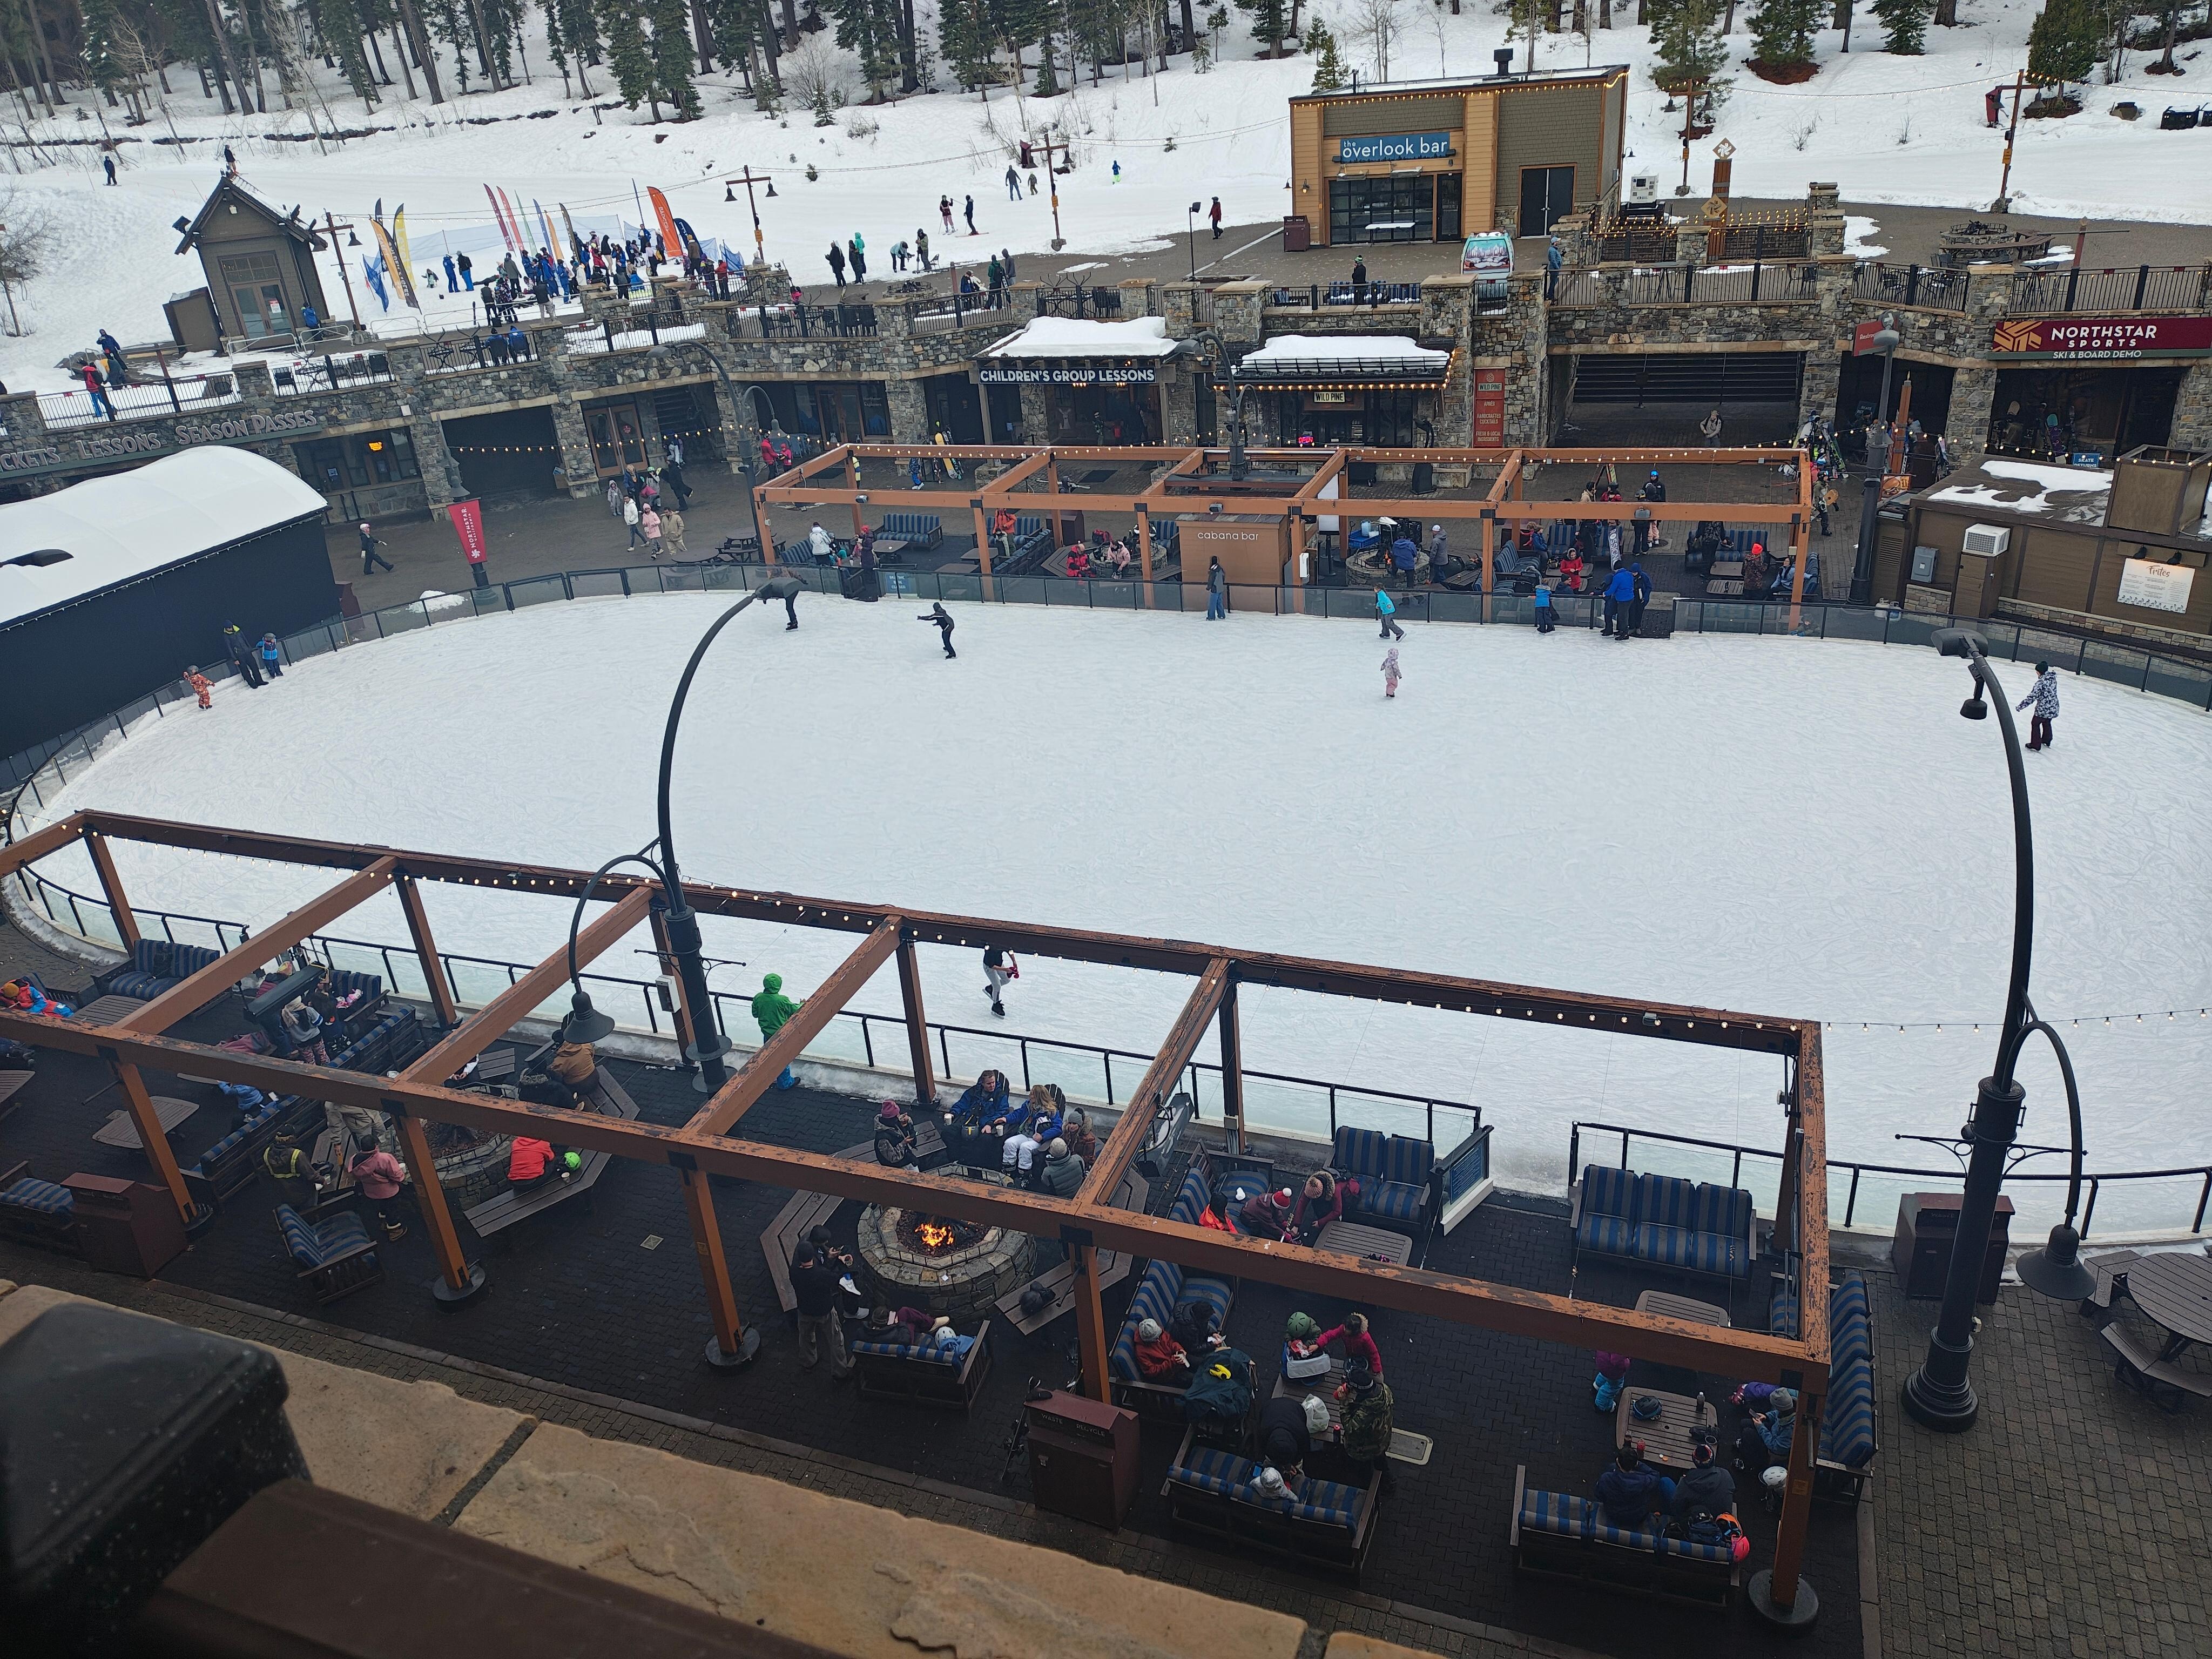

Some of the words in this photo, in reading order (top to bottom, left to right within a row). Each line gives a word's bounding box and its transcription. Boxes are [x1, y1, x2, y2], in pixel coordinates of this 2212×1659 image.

[1343, 138, 1414, 158] overlook
[1420, 137, 1447, 153] bar
[2051, 325, 2157, 340] NORTHSTAR
[2068, 339, 2136, 348] SPORTS
[2112, 350, 2142, 358] DEMO
[980, 370, 1050, 382] CHILDREN'S
[1053, 369, 1096, 382] GROUP
[1098, 369, 1155, 381] LESSONS
[1316, 393, 1329, 401] WILD
[1331, 393, 1344, 401] PINE
[0, 447, 60, 472] CKETS
[75, 433, 161, 460] LESSONS
[175, 420, 249, 445] SEASON
[250, 409, 317, 434] PASSES
[461, 508, 476, 548] NORTHSTAR
[1197, 531, 1239, 539] cabana
[1242, 531, 1259, 540] bar
[2146, 565, 2170, 577] Frites
[1041, 1413, 1063, 1424] WASTE
[1076, 1424, 1105, 1437] RECYCLE
